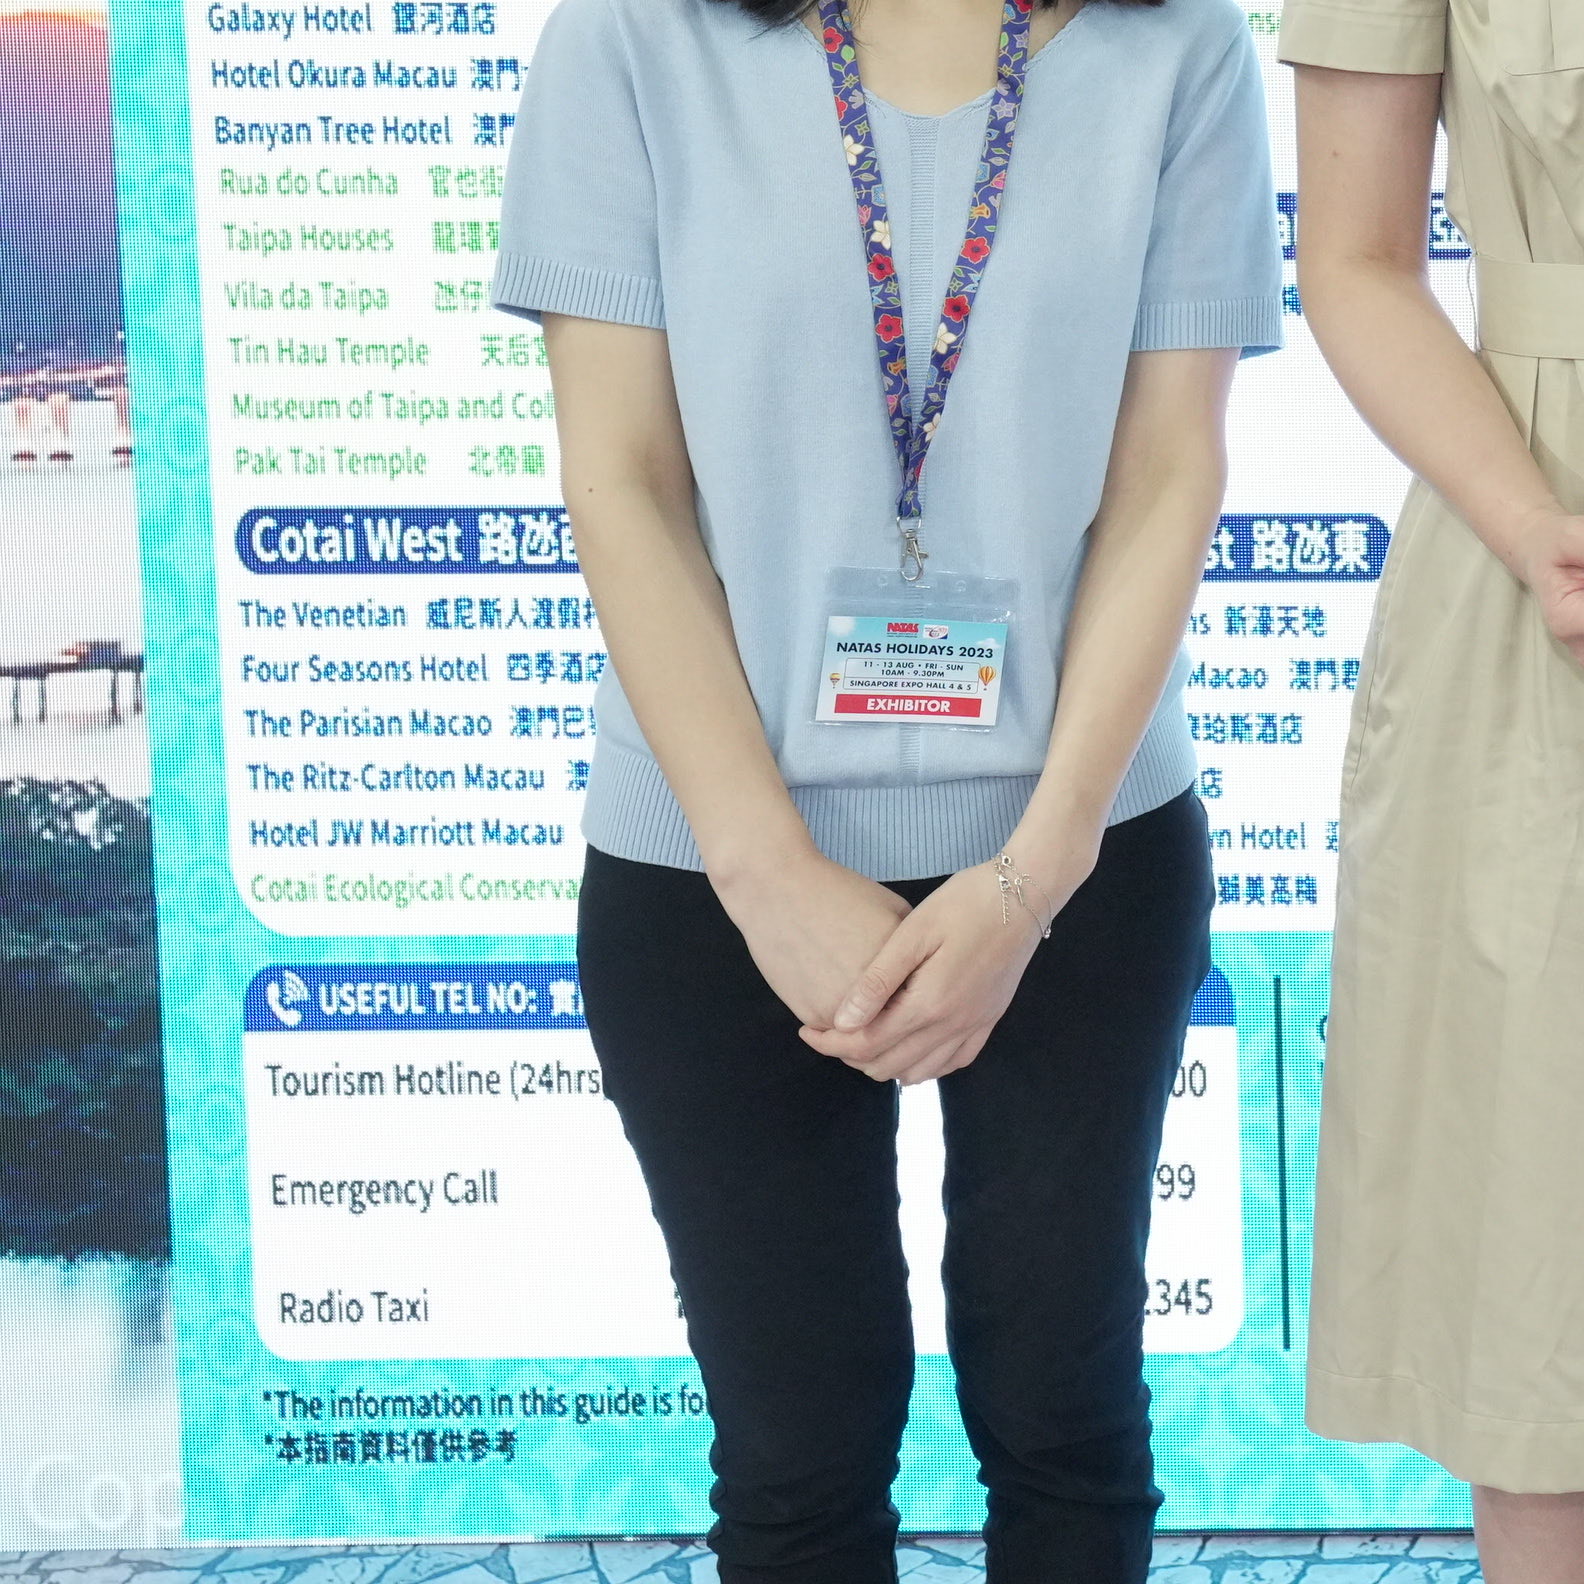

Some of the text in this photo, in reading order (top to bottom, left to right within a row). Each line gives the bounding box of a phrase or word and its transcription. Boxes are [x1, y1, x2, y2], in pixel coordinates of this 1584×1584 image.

[211, 58, 457, 89] Hotel Okura Macau
[214, 113, 453, 152] Banyan Tree Hotel
[220, 166, 398, 196] Rua do Cunha
[223, 222, 394, 257] Taipa Houses
[229, 335, 430, 371] Tin Hau Temple
[232, 390, 503, 425] Museum of Taipa and
[253, 512, 463, 564] Cotai West
[239, 598, 408, 629] The Venetian
[836, 642, 994, 659] NATAS HOLIDAYS 2023
[241, 653, 491, 683] Four Seasons Hotel
[850, 679, 946, 690] SINGAPORE EXPO HALL
[914, 670, 945, 678] 9.30PM
[866, 698, 950, 713] EXHIBITOR
[243, 707, 493, 738] The Parisian Macao
[246, 761, 545, 792] The Ritz-Carlton Macau
[249, 816, 566, 848] Hotel JW Marriott Macau
[251, 872, 453, 909] Cotai Ecological
[319, 980, 538, 1016] USEFUL TEL NO:
[265, 1060, 502, 1097] Tourism Hotline
[271, 1169, 499, 1214] Emergency Call
[279, 1289, 430, 1324] Radio Taxi
[329, 1388, 483, 1418] information
[490, 1388, 513, 1417] in
[520, 1387, 568, 1417] this
[575, 1387, 647, 1424] guide
[651, 1387, 671, 1416] is
